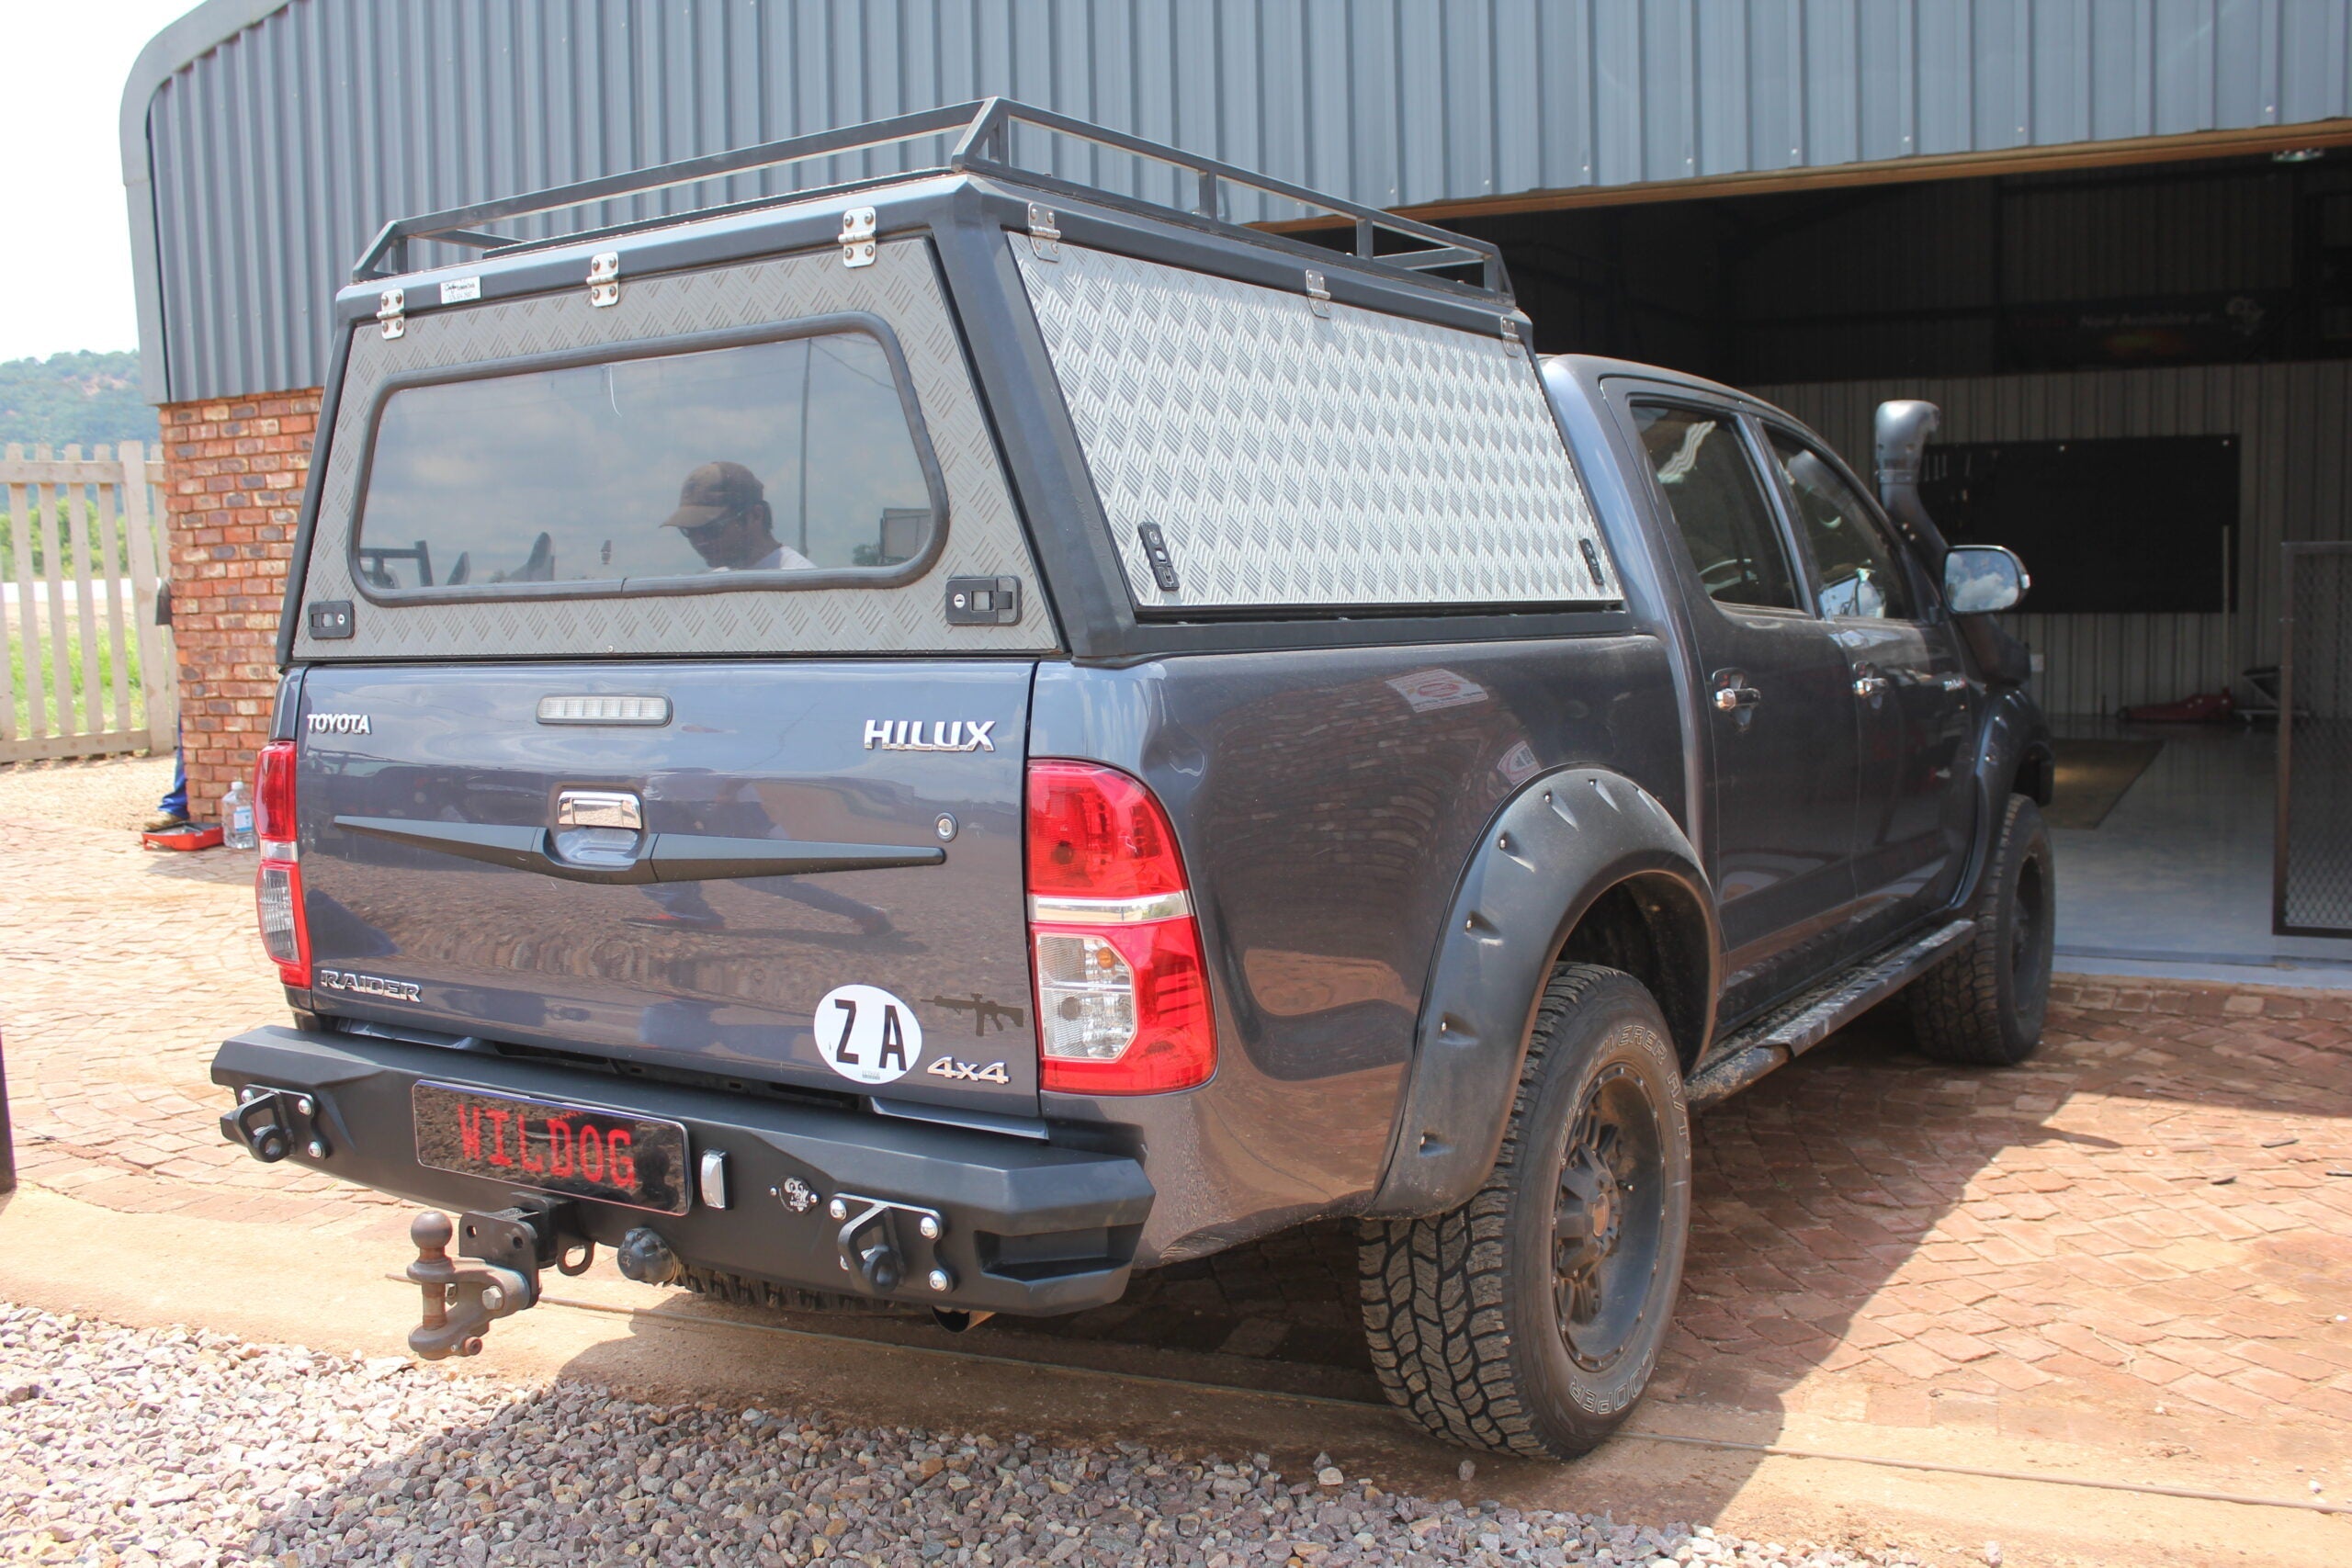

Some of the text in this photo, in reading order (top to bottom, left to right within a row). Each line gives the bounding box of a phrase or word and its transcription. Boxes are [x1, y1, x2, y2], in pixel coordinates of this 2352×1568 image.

[306, 712, 371, 735] TOYOTA
[864, 719, 996, 751] HILUX
[320, 969, 423, 1003] RAIDER
[927, 1056, 1010, 1084] 4x4
[458, 1103, 636, 1189] WILDOG
[1568, 1347, 1656, 1415] COOPER
